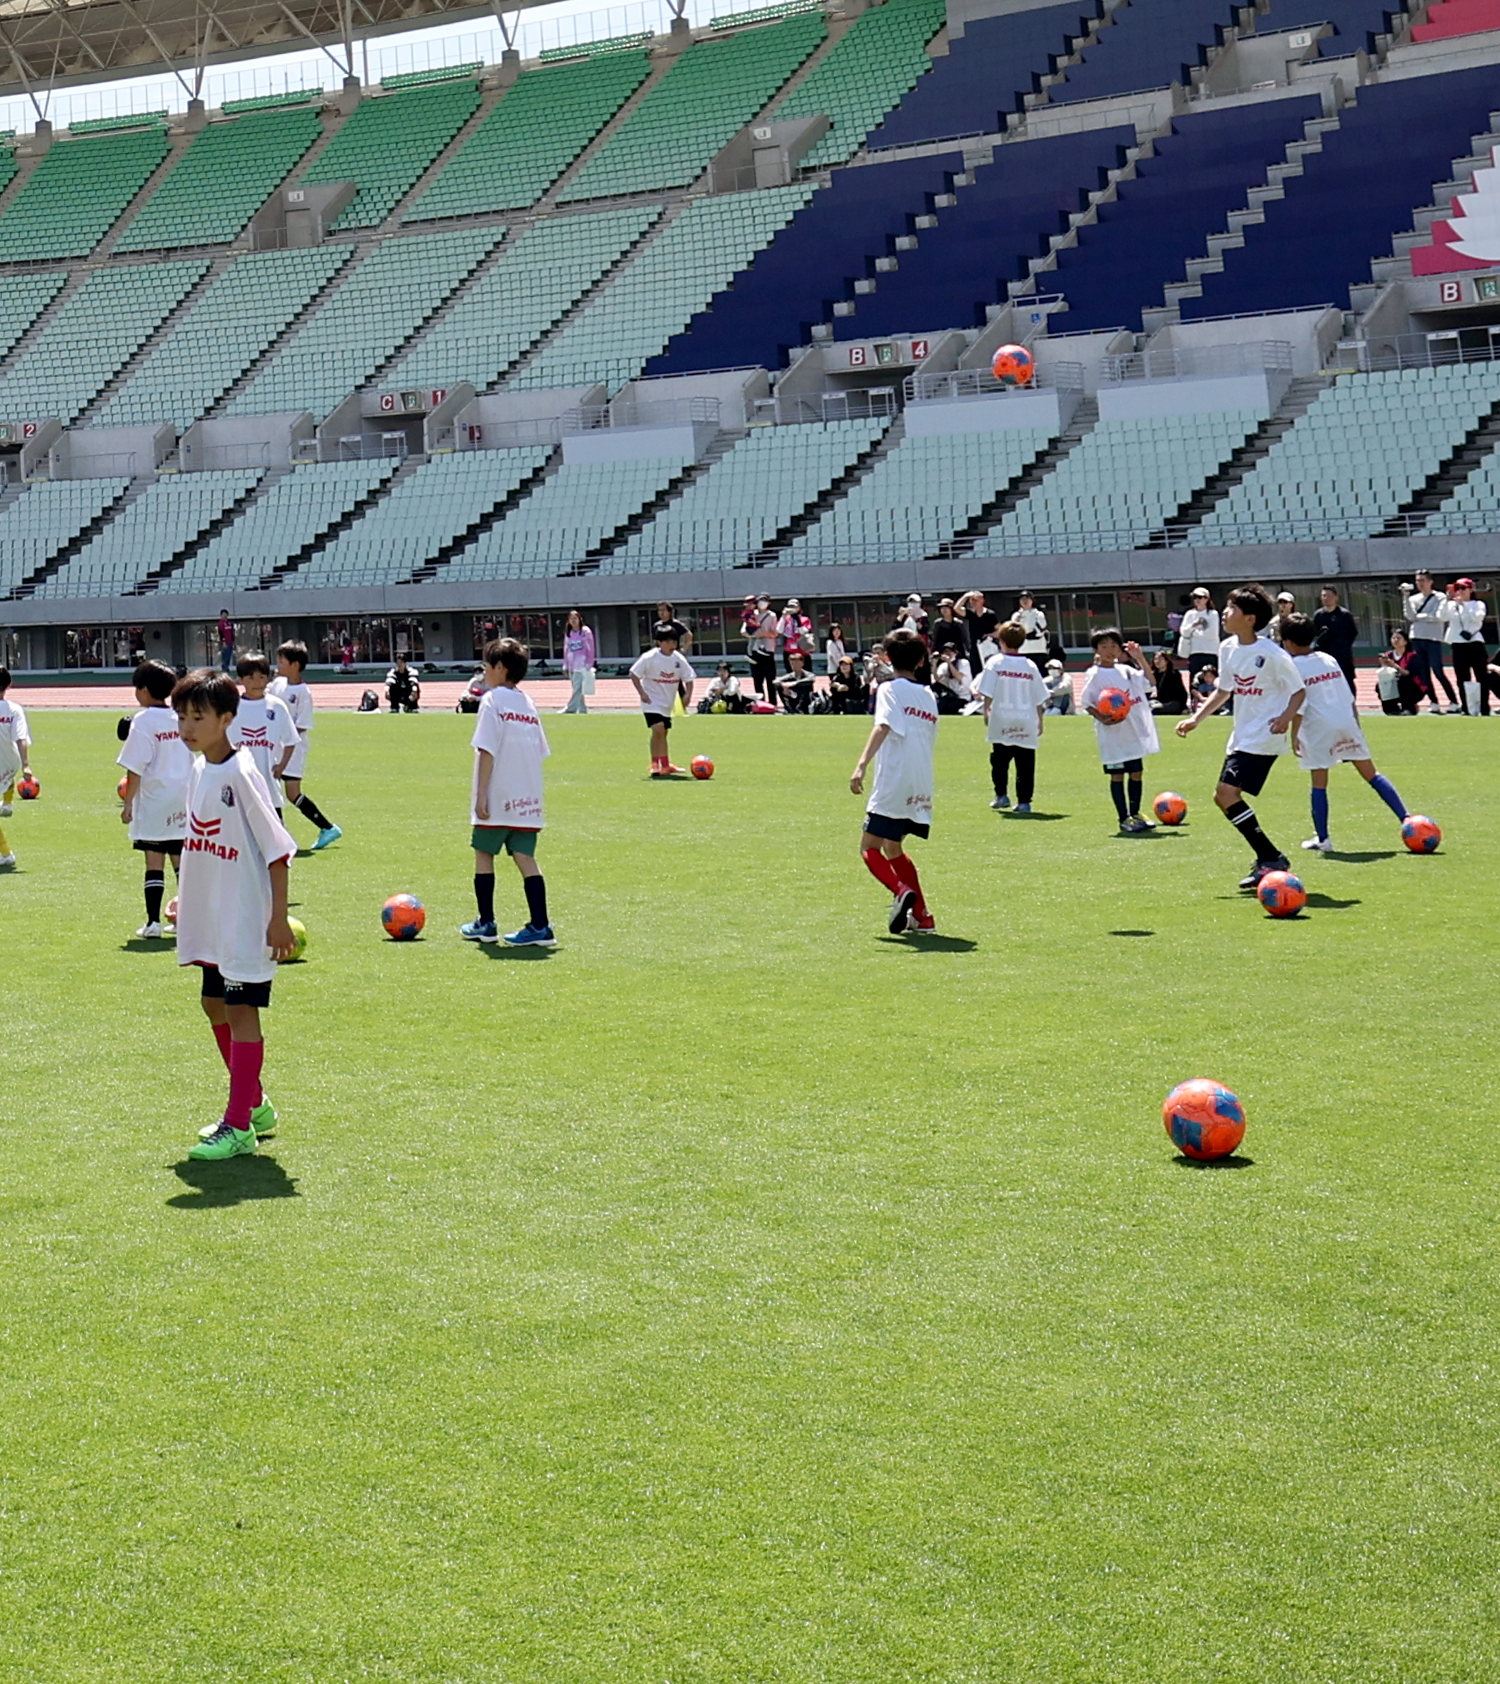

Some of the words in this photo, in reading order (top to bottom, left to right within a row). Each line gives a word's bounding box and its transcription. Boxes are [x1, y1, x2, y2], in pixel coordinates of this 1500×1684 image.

[1443, 284, 1458, 300] B
[852, 349, 863, 364] B
[915, 342, 925, 357] 4
[382, 396, 392, 410] C
[436, 391, 442, 404] 1
[26, 425, 35, 437] 2
